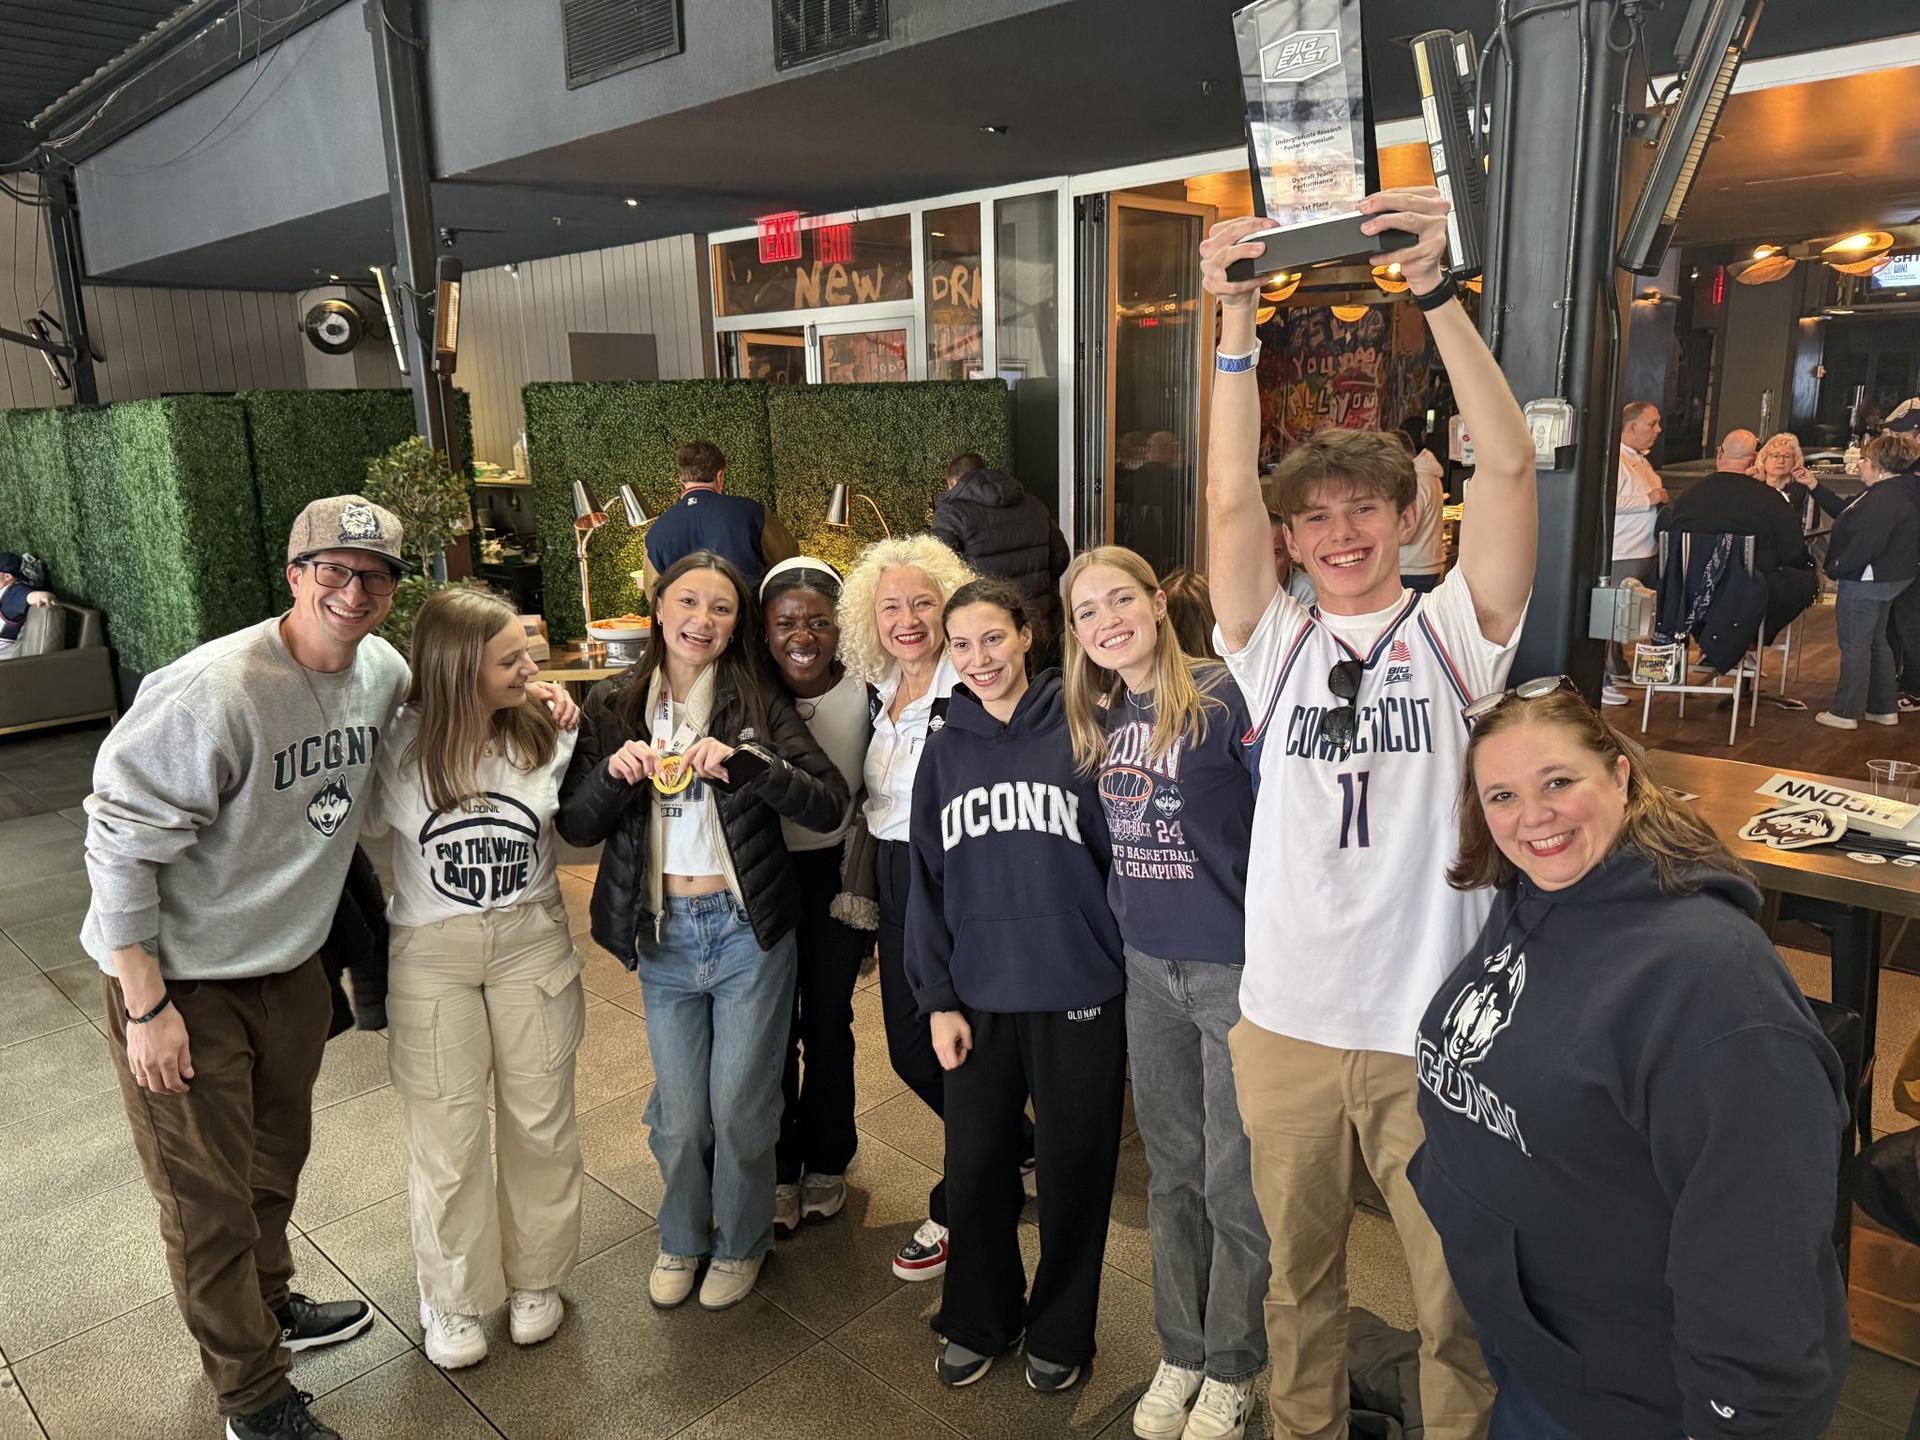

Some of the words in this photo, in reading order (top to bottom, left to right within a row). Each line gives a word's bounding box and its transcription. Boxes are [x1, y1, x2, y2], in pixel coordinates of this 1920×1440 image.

[1281, 37, 1319, 58] BIG
[1277, 46, 1329, 70] EAST
[1275, 131, 1317, 146] Undergraduate
[1316, 125, 1342, 136] Research
[1283, 142, 1302, 151] Poster
[1302, 135, 1335, 148] Symposium
[1291, 173, 1315, 184] Overall
[1316, 170, 1334, 178] Team
[1292, 178, 1334, 192] Performance
[1312, 200, 1329, 210] Place
[764, 216, 798, 260] EXIT
[1385, 673, 1414, 682] EAST
[1387, 666, 1410, 675] BIG
[940, 781, 1082, 852] UCONN
[1337, 771, 1370, 849] 11
[1155, 819, 1186, 846] 24
[435, 841, 463, 865] FOR
[1126, 846, 1200, 863] BASKETBALL
[1125, 861, 1195, 880] CHAMPIONS
[1067, 1009, 1084, 1020] OLD
[1083, 1005, 1102, 1019] NAVY
